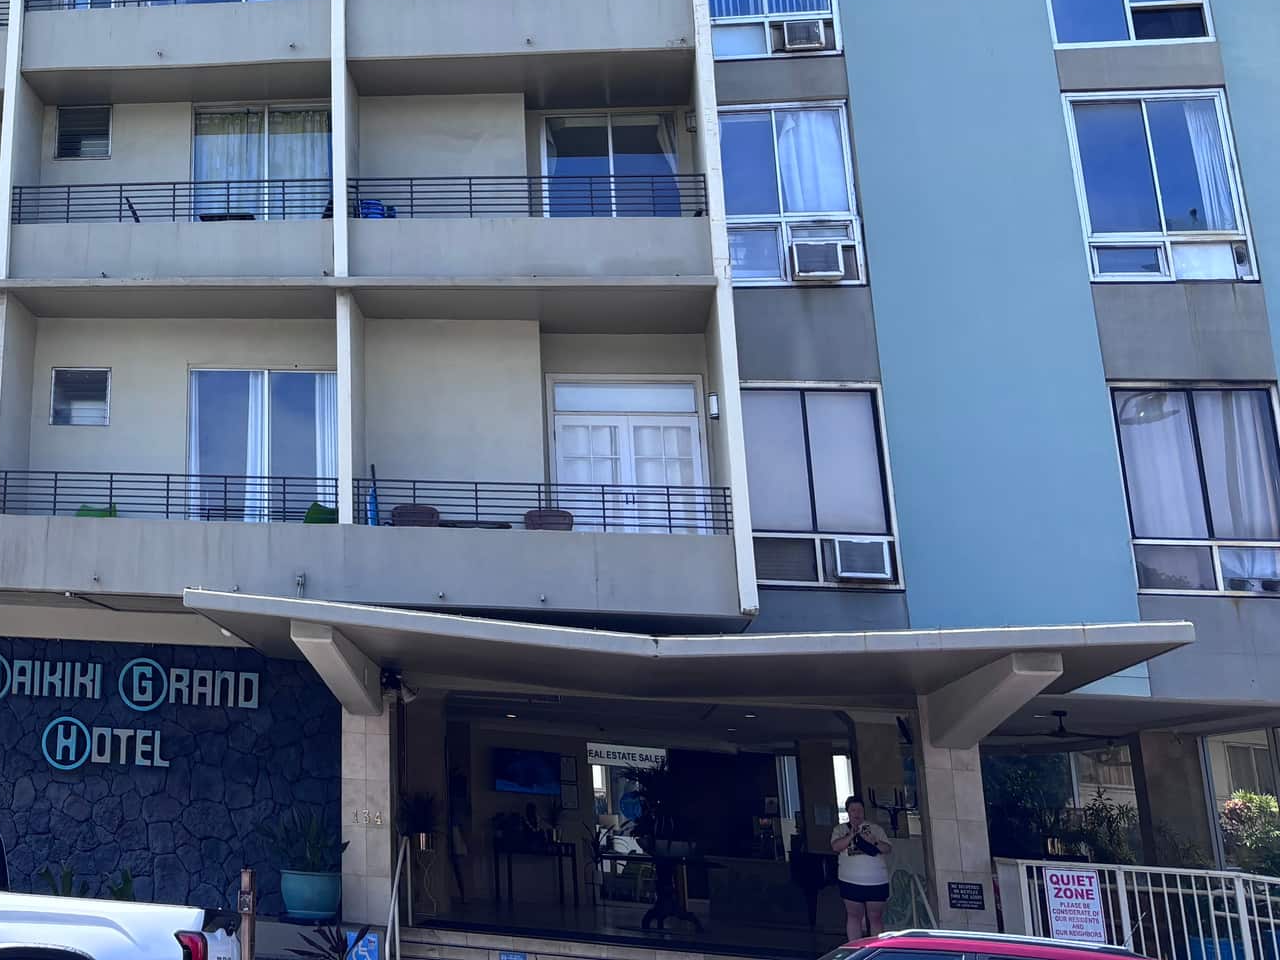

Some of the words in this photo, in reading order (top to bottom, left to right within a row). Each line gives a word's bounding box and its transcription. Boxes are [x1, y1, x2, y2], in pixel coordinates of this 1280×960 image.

[131, 665, 260, 709] GRAND
[55, 724, 170, 768] HOTEL
[606, 751, 637, 761] ESTATE
[1049, 874, 1094, 887] QUIET
[1053, 887, 1095, 900] ZONE
[1052, 908, 1092, 916] CONSIDERATE
[1068, 916, 1099, 924] RESIDENTS
